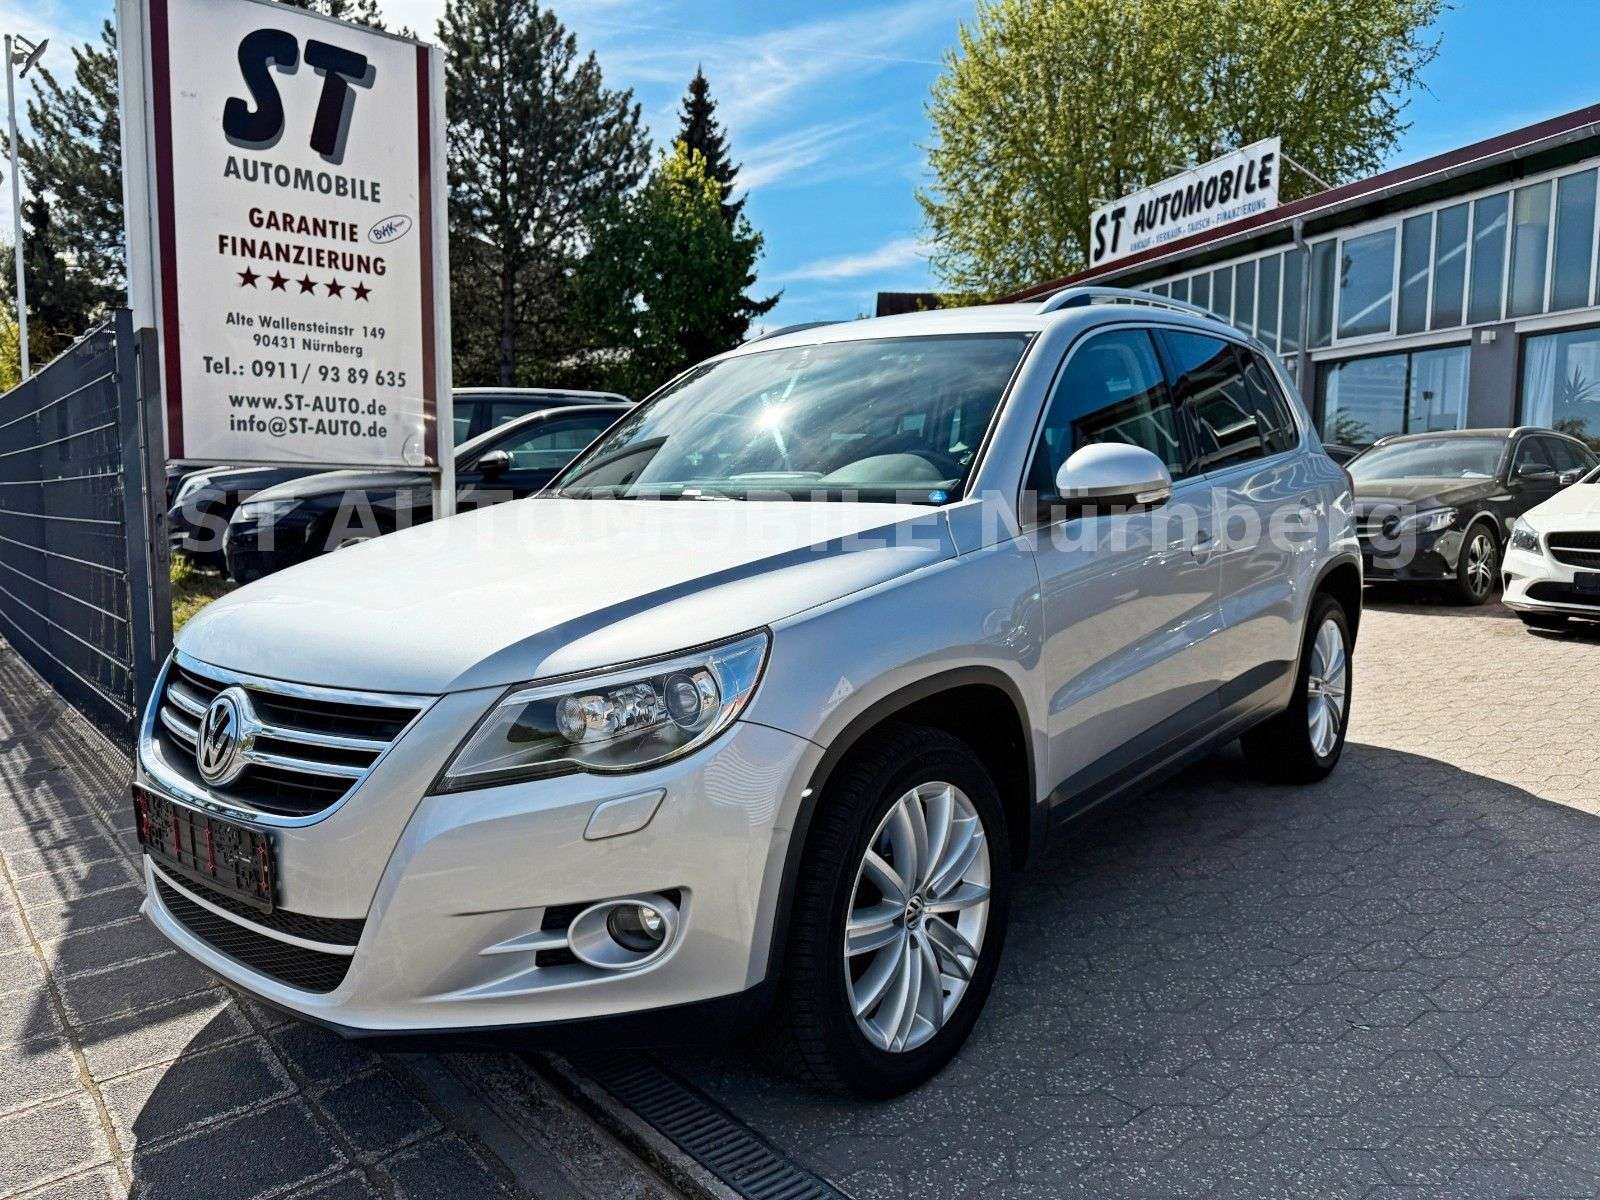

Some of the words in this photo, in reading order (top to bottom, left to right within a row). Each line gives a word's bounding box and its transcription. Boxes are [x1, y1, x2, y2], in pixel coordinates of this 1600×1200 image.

[223, 28, 376, 165] ST
[223, 156, 381, 203] AUTOMOBILE
[1094, 207, 1126, 262] ST
[1134, 152, 1274, 235] AUTOMOBILE
[249, 207, 359, 242] GARANTIE
[218, 234, 387, 276] FINANZIERUNG
[226, 312, 254, 327] Alte
[258, 314, 355, 337] Wallensteinstr
[362, 325, 386, 340] 149
[253, 334, 296, 350] 90431
[302, 337, 363, 358] Nürnberg
[203, 356, 244, 376] Tel.:
[252, 359, 311, 384] 0911/
[318, 365, 340, 383] 93
[347, 367, 369, 385] 89
[375, 369, 406, 388] 635
[229, 394, 387, 416] www.ST-AUTO.de
[230, 415, 388, 438] info@ST-AUTO.de
